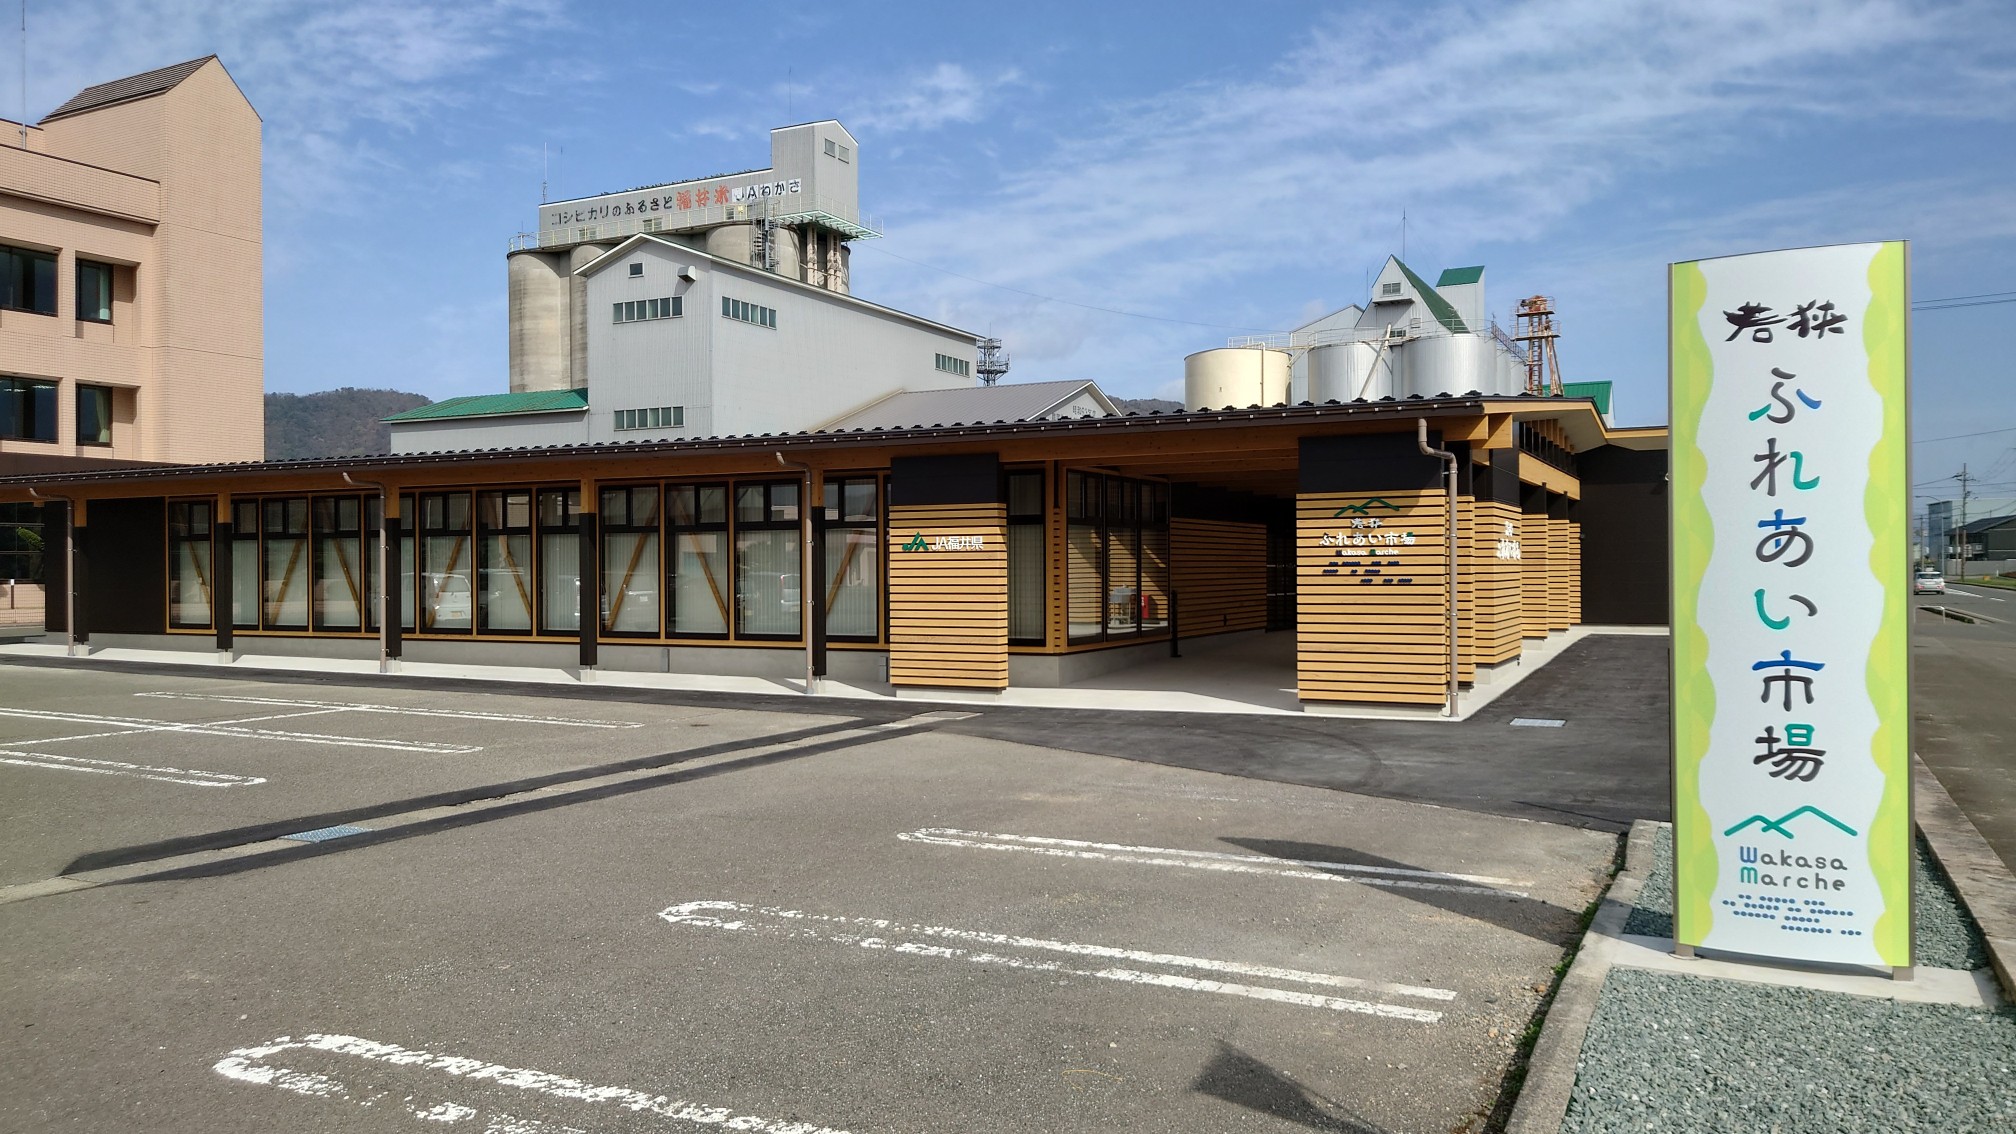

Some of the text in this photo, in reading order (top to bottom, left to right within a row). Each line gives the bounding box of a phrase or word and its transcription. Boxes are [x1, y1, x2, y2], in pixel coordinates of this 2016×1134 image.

[1723, 299, 1848, 343] 若狭
[931, 536, 983, 551] JA福井県
[1319, 531, 1416, 546] ふれあい市場
[1749, 367, 1826, 783] ふれあい市場
[1740, 846, 1847, 871] Wakasa
[1740, 866, 1845, 891] Marche
